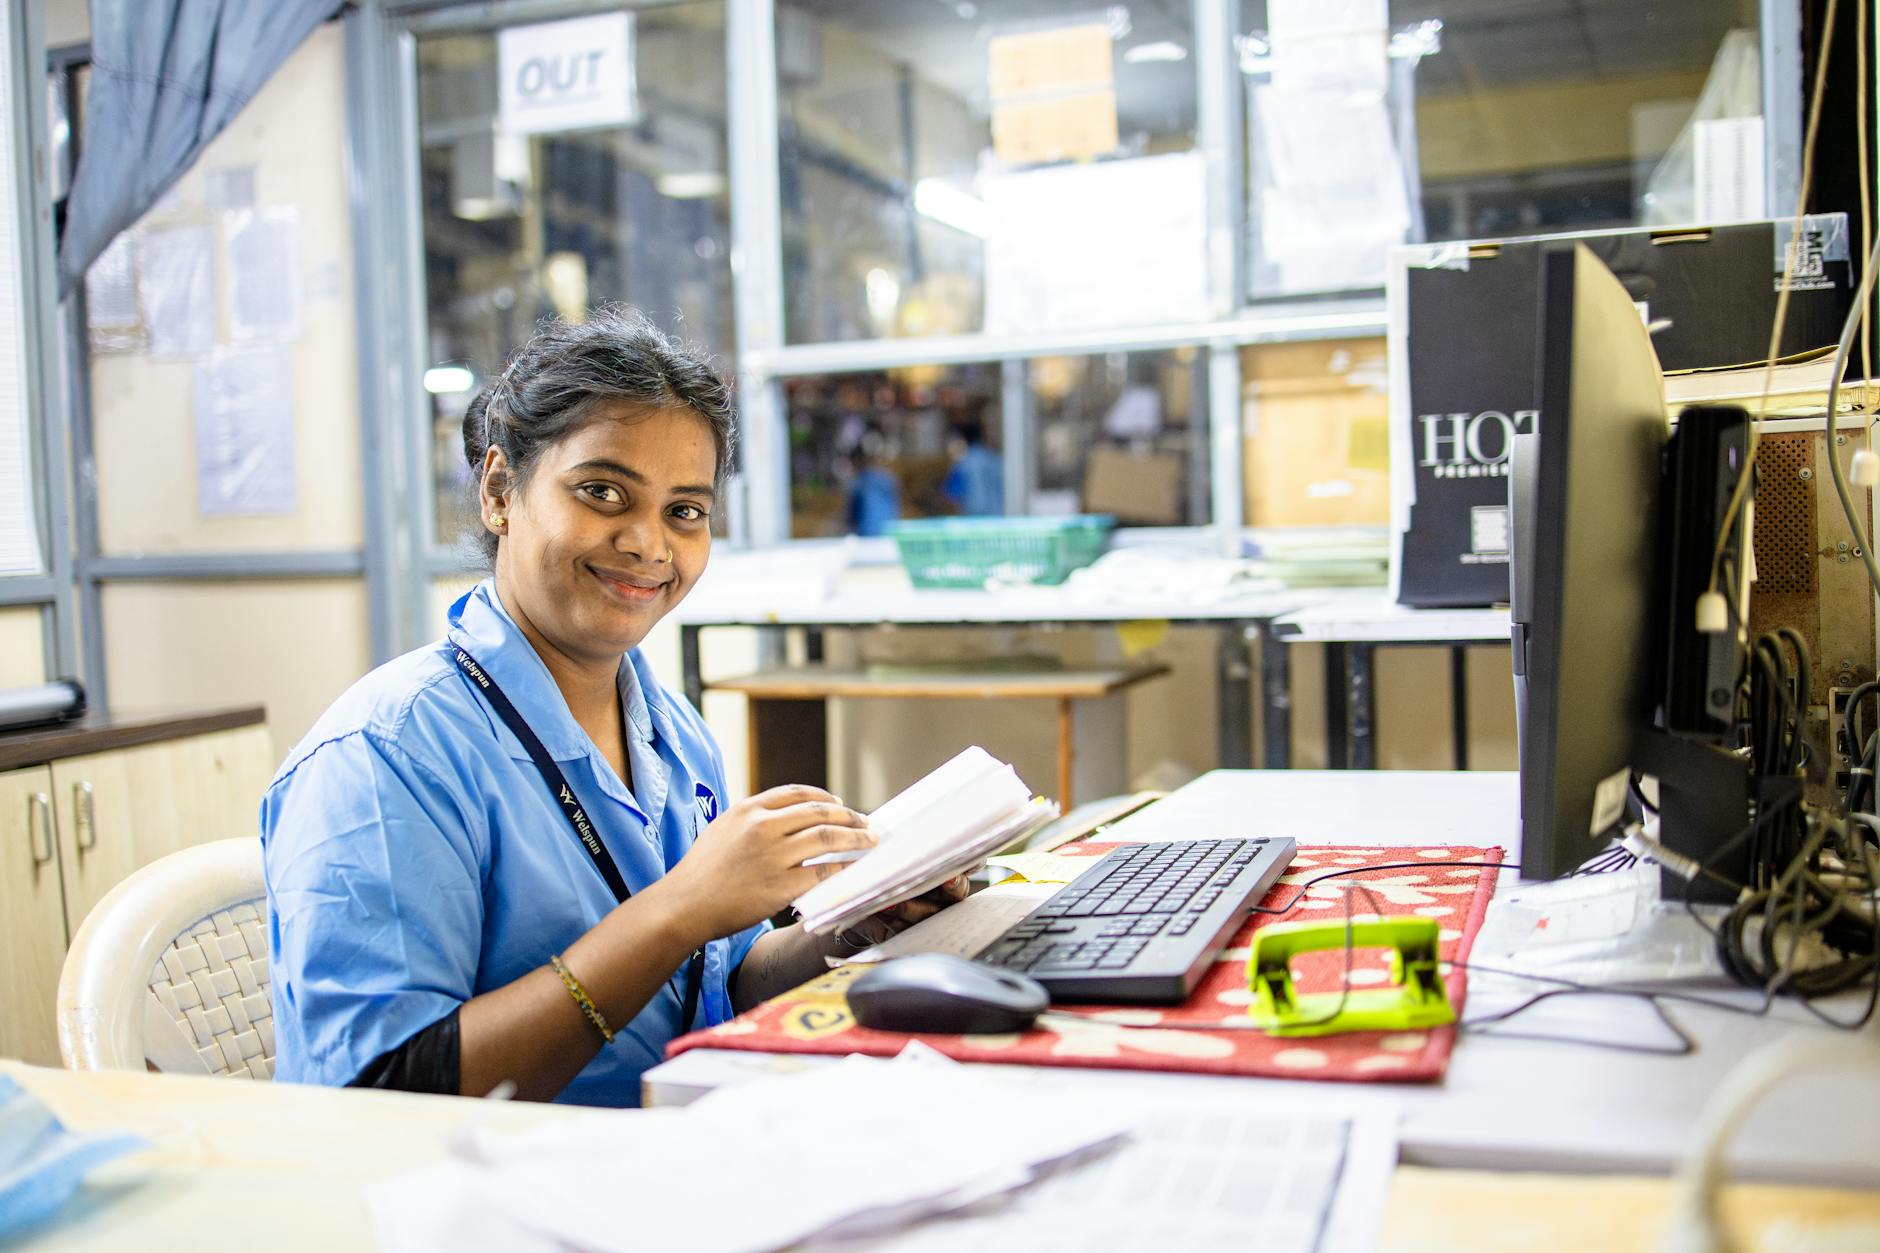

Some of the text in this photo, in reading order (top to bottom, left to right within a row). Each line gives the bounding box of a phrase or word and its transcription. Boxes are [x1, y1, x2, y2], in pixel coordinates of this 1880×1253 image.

[517, 49, 606, 97] OUT
[456, 651, 490, 688] Welspun
[572, 809, 602, 855] Welspun
